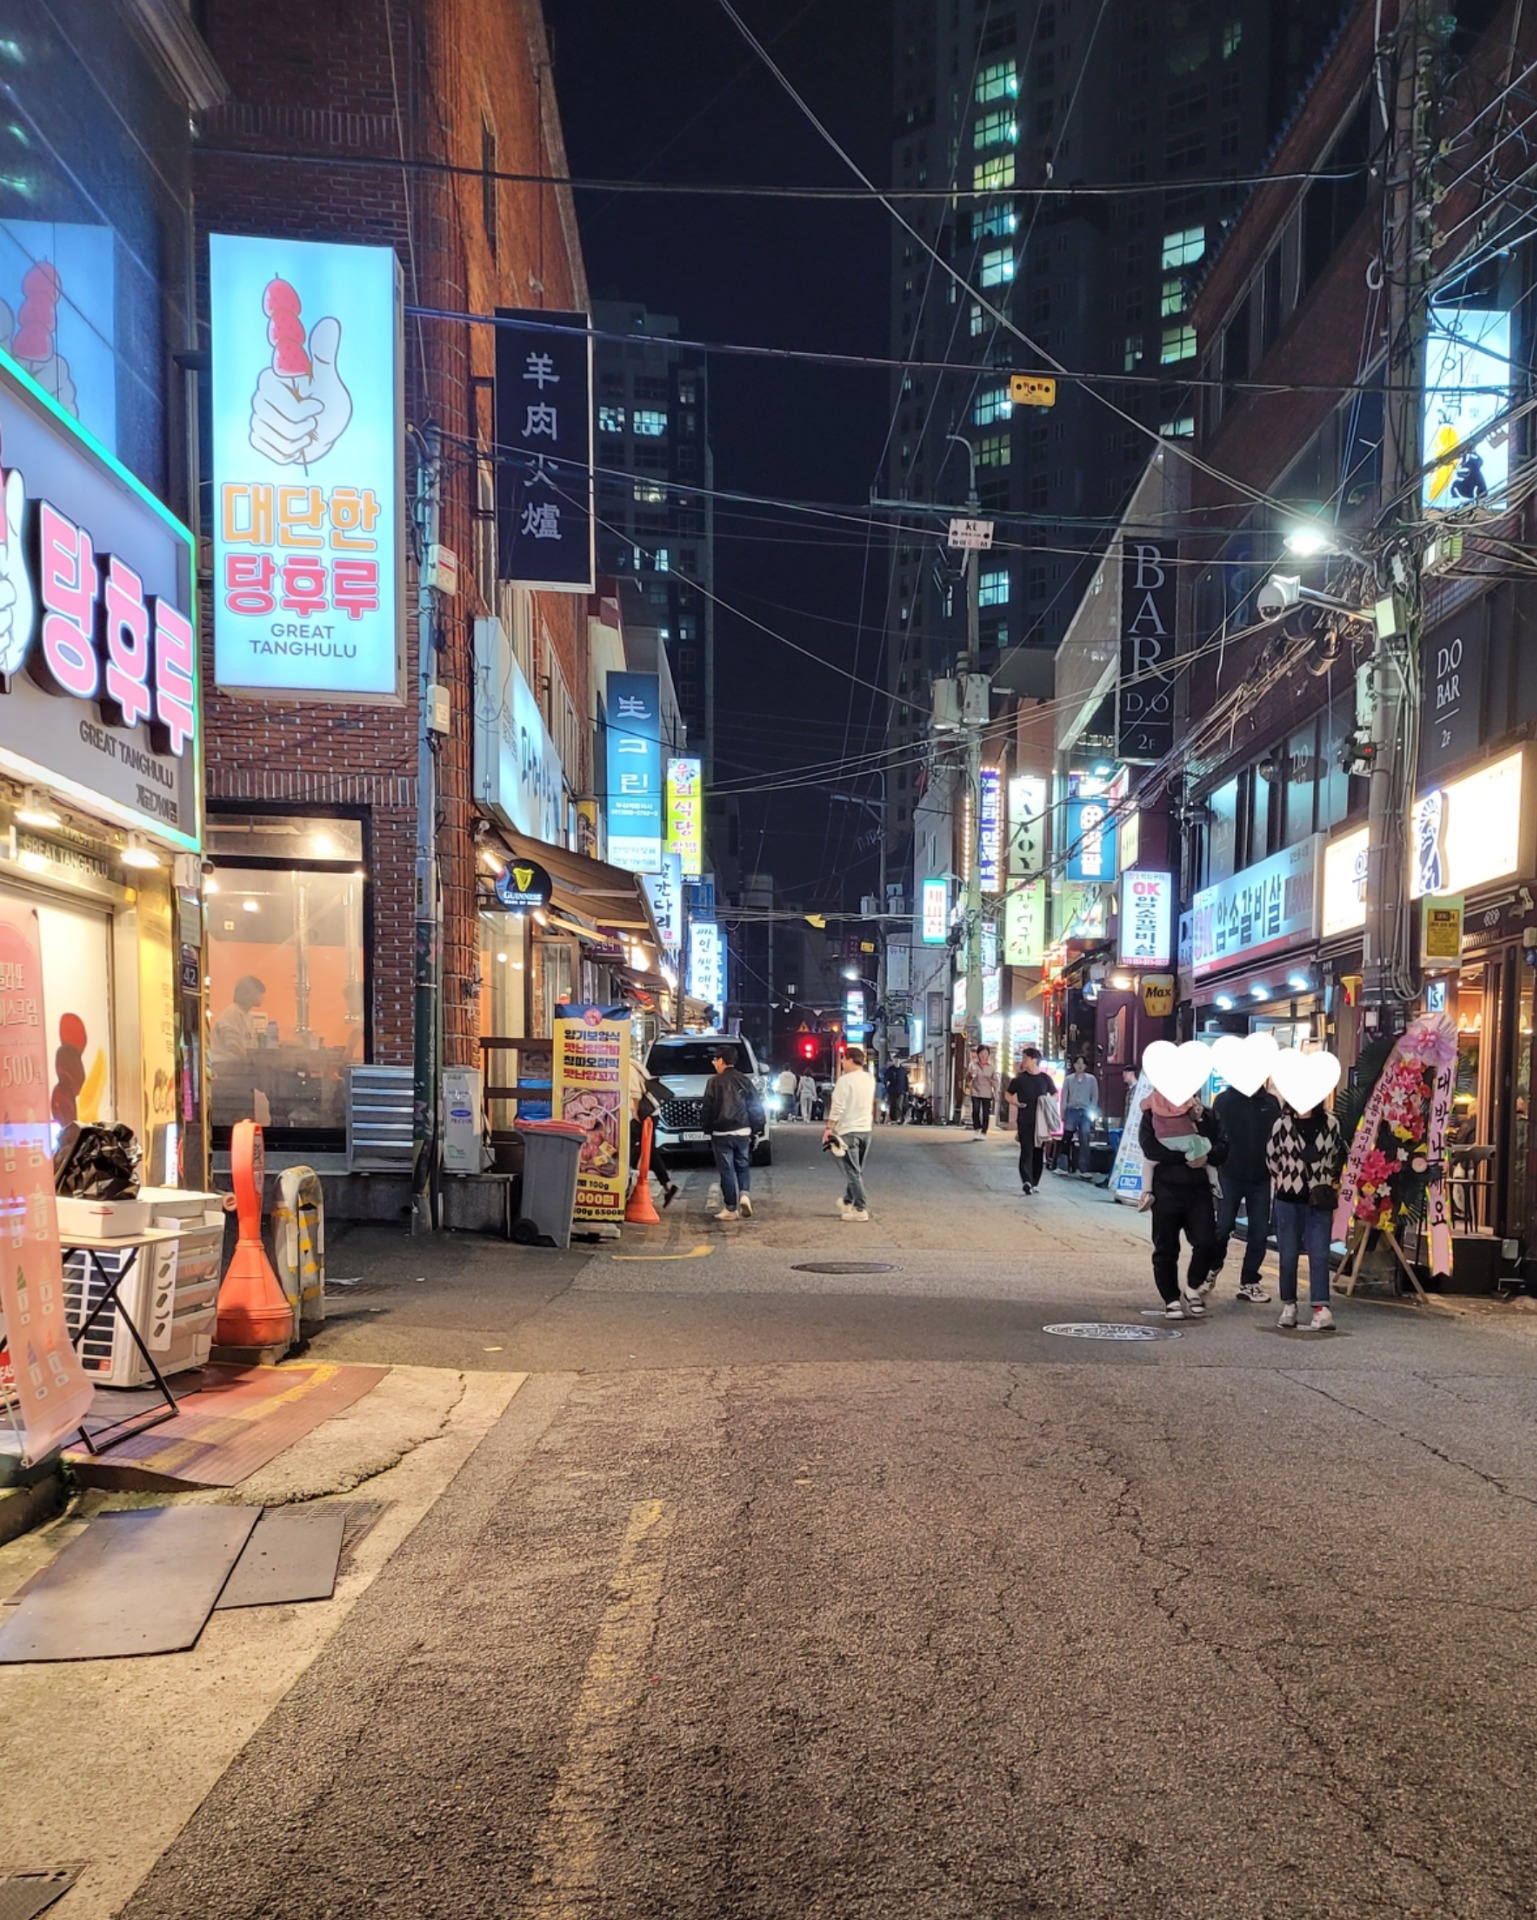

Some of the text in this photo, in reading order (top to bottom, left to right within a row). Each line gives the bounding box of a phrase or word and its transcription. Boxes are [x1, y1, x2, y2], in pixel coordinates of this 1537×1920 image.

[521, 352, 562, 540] 羊肉火爐
[222, 482, 381, 552] 대단한
[225, 553, 380, 621] 탕후루
[40, 499, 195, 758] 탕후루
[270, 623, 335, 639] GREAT
[1128, 544, 1171, 682] BAR
[249, 640, 357, 659] TANGHULU
[1437, 638, 1463, 679] D.O
[1126, 692, 1169, 713] D.O
[1436, 674, 1460, 709] BAR
[80, 719, 174, 790] GREAT TANGHULU
[503, 890, 543, 901] GUINNESS
[1133, 881, 1160, 896] OK
[1216, 873, 1282, 953] 암소갈비살
[1146, 986, 1172, 998] Max
